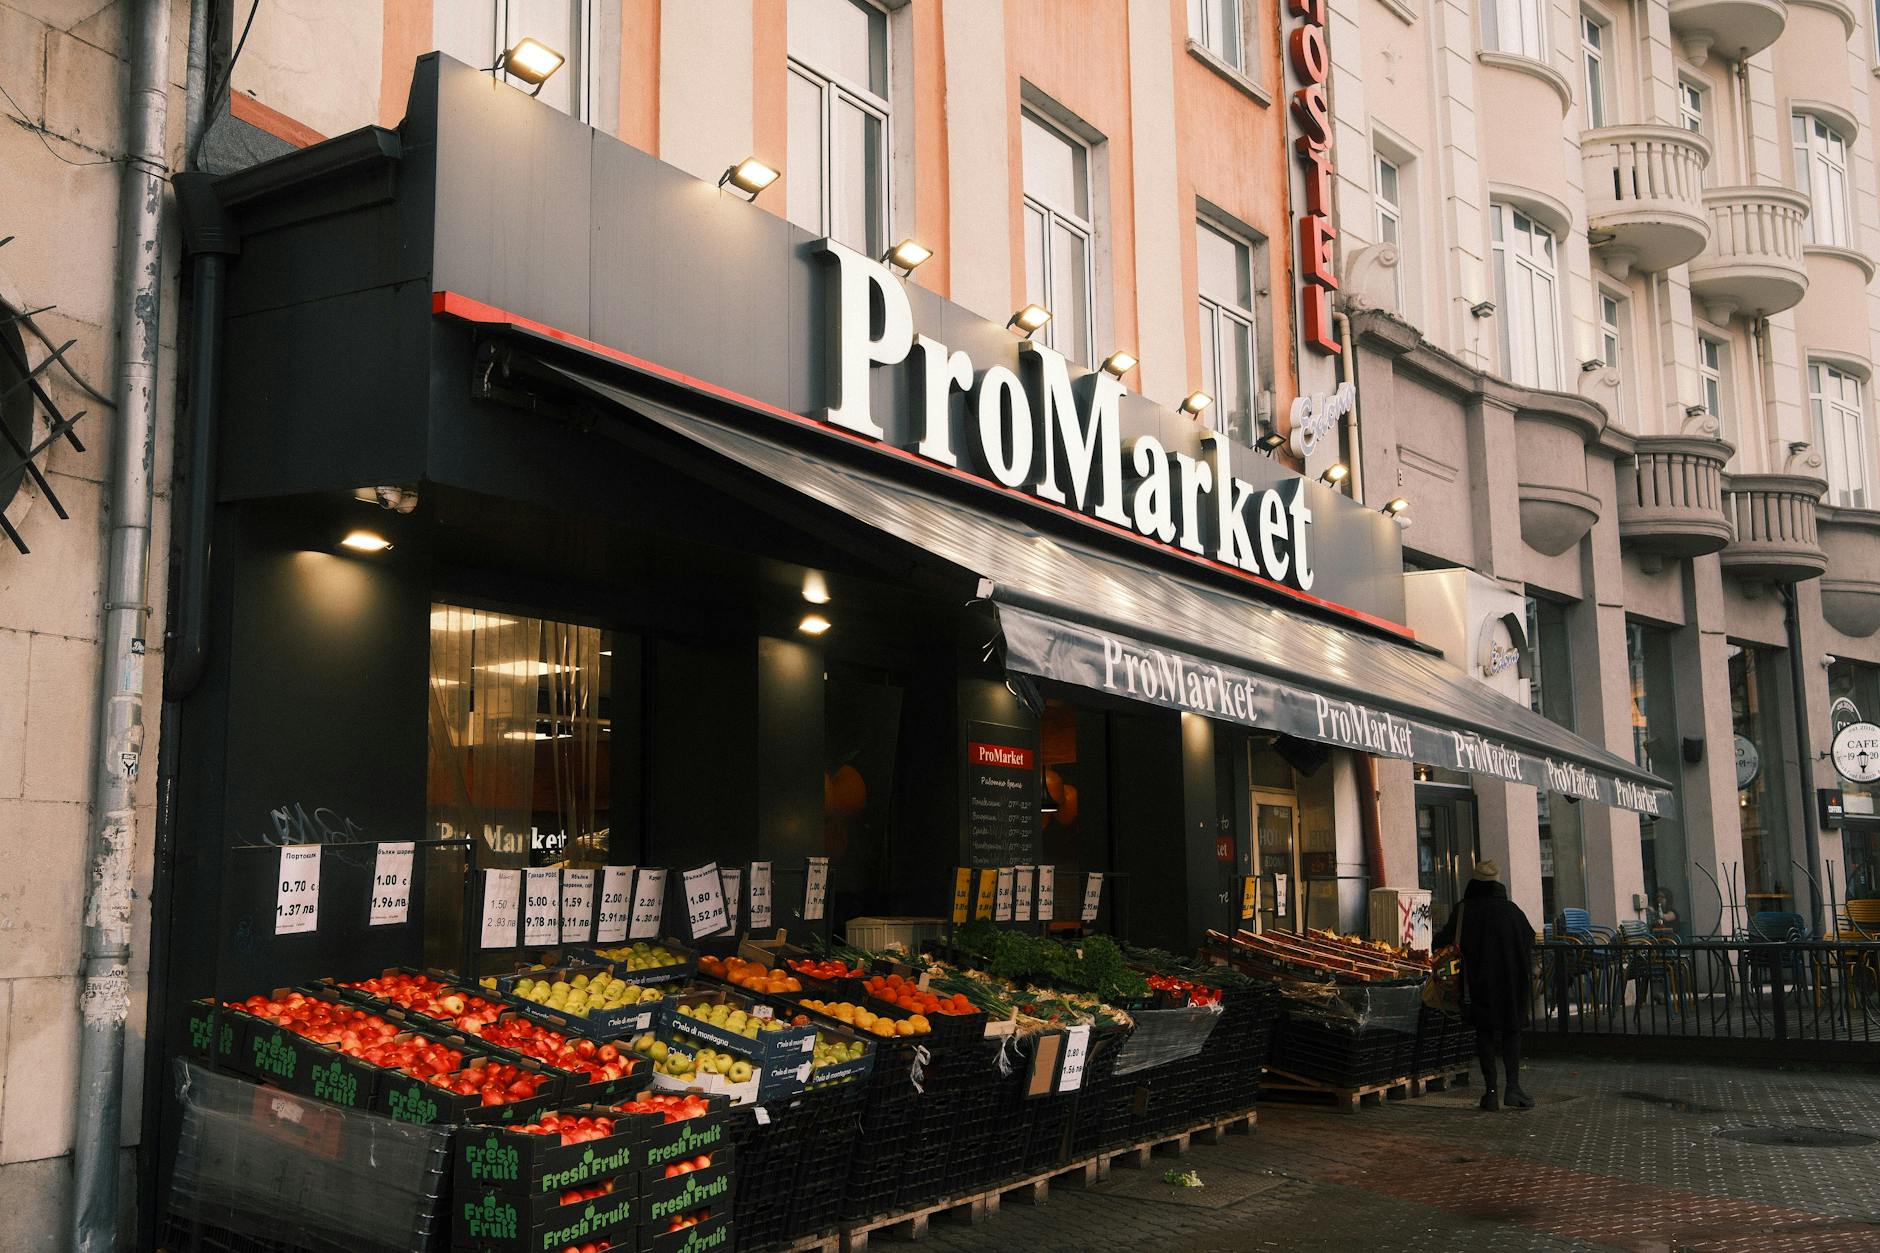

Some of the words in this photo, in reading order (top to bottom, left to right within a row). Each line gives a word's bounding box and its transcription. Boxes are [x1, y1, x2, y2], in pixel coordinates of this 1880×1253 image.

[818, 238, 1314, 591] ProMarket
[1101, 637, 1257, 721] ProMarket
[1312, 693, 1414, 758] ProMarket
[1847, 739, 1879, 749] CAFE
[979, 746, 1024, 766] ProMarket
[1452, 731, 1523, 781] ProMarket
[1848, 752, 1856, 761] 19
[1869, 751, 1879, 760] 20
[1545, 757, 1600, 801] ProMarket
[1614, 778, 1659, 814] ProMarket
[435, 822, 567, 854] PMarket
[282, 880, 307, 892] 0.70
[376, 875, 397, 886] 1.00
[372, 897, 394, 908] 1.96
[394, 898, 407, 907] лв
[490, 899, 508, 909] 1.50
[528, 896, 548, 907] 5.00
[564, 897, 582, 907] 1.59
[604, 893, 622, 904] 2.00
[640, 898, 655, 907] 2.20
[690, 891, 710, 905] 1.80
[277, 904, 301, 916] 1.37
[303, 904, 315, 914] лв
[600, 913, 617, 922] 3.91
[636, 913, 652, 923] 4.30
[690, 910, 711, 924] 3.52
[712, 908, 723, 918] лв
[487, 917, 506, 927] 2.93
[506, 919, 517, 927] лв
[526, 917, 545, 927] 9.78
[547, 918, 557, 927] лв
[579, 919, 590, 927] лв
[190, 1017, 233, 1042] Freh
[672, 1020, 690, 1033] Mela
[690, 1026, 697, 1036] di
[697, 1030, 729, 1047] montagna
[193, 1032, 232, 1055] Frit
[254, 1035, 297, 1062] Fresh
[1067, 1048, 1080, 1057] 0.80
[255, 1053, 296, 1079] Fruit
[312, 1065, 358, 1090] Fresh
[314, 1080, 356, 1106] Fruit
[389, 1089, 438, 1119] Fresh
[391, 1106, 435, 1126] Fruit
[465, 1145, 519, 1164] Fresh
[648, 1140, 687, 1166] Fresh
[689, 1125, 722, 1148] Fruit
[471, 1161, 519, 1180] Fruit
[542, 1165, 589, 1193] Fresh
[591, 1148, 631, 1169] Fruit
[652, 1192, 691, 1220] Fresh
[693, 1176, 728, 1202] Fruit
[464, 1202, 518, 1221] Fresh
[469, 1219, 518, 1239] Fruit
[543, 1218, 589, 1251] Fresh
[592, 1201, 631, 1223] Fruit
[692, 1226, 728, 1249] Fruit
